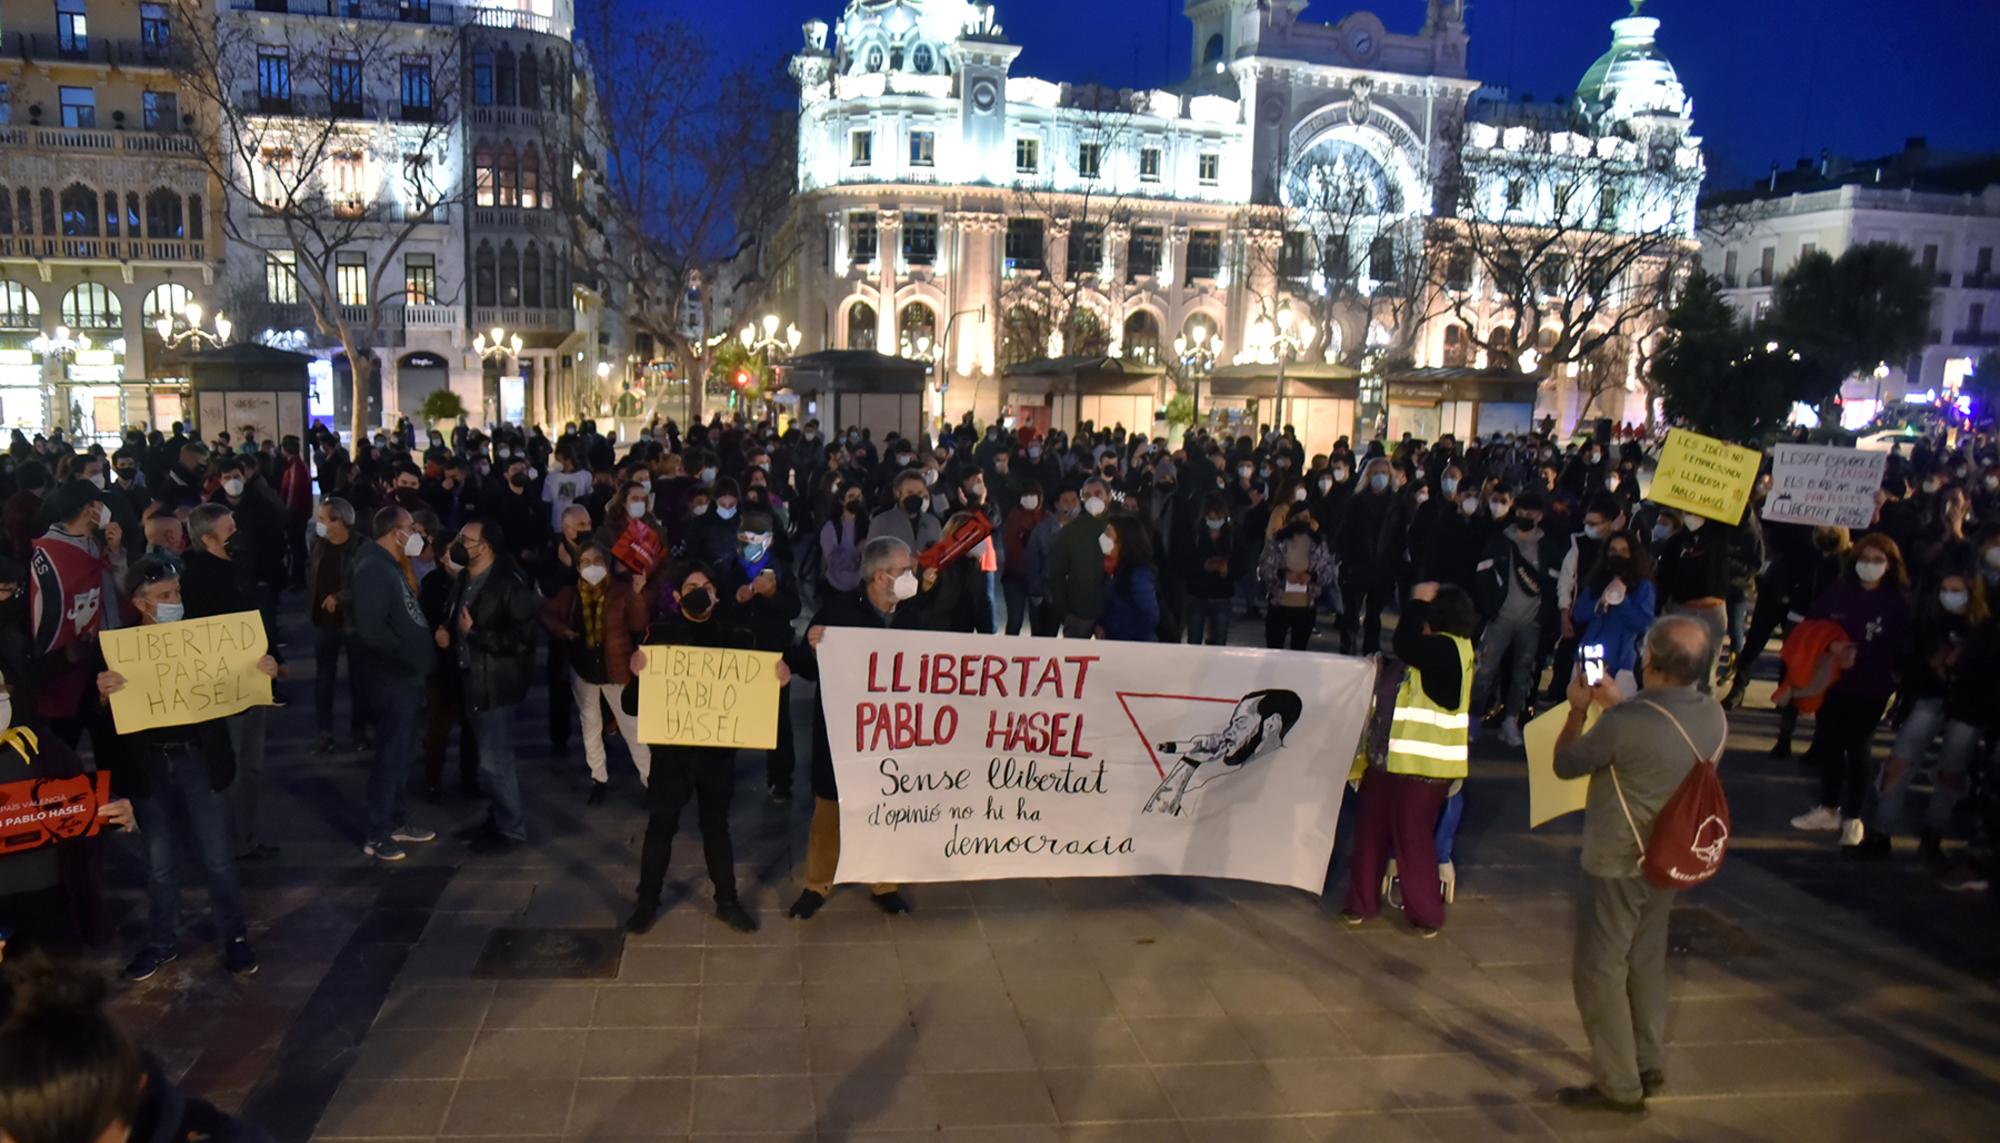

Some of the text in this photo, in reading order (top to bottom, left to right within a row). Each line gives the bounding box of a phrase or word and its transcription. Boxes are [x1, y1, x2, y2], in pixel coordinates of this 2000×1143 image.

[116, 620, 256, 664] LIBERTAD
[155, 656, 230, 688] PARA
[649, 645, 761, 684] LIBERTAD
[867, 650, 1101, 699] LLIBERTAT
[665, 678, 738, 712] PABLO
[855, 700, 1094, 759] PABLO HASEL
[880, 756, 1109, 797] Sense llibertat
[5, 811, 47, 826] PABLO
[868, 796, 1043, 832] d'opinió no hi ha
[943, 823, 1137, 859] democracia
